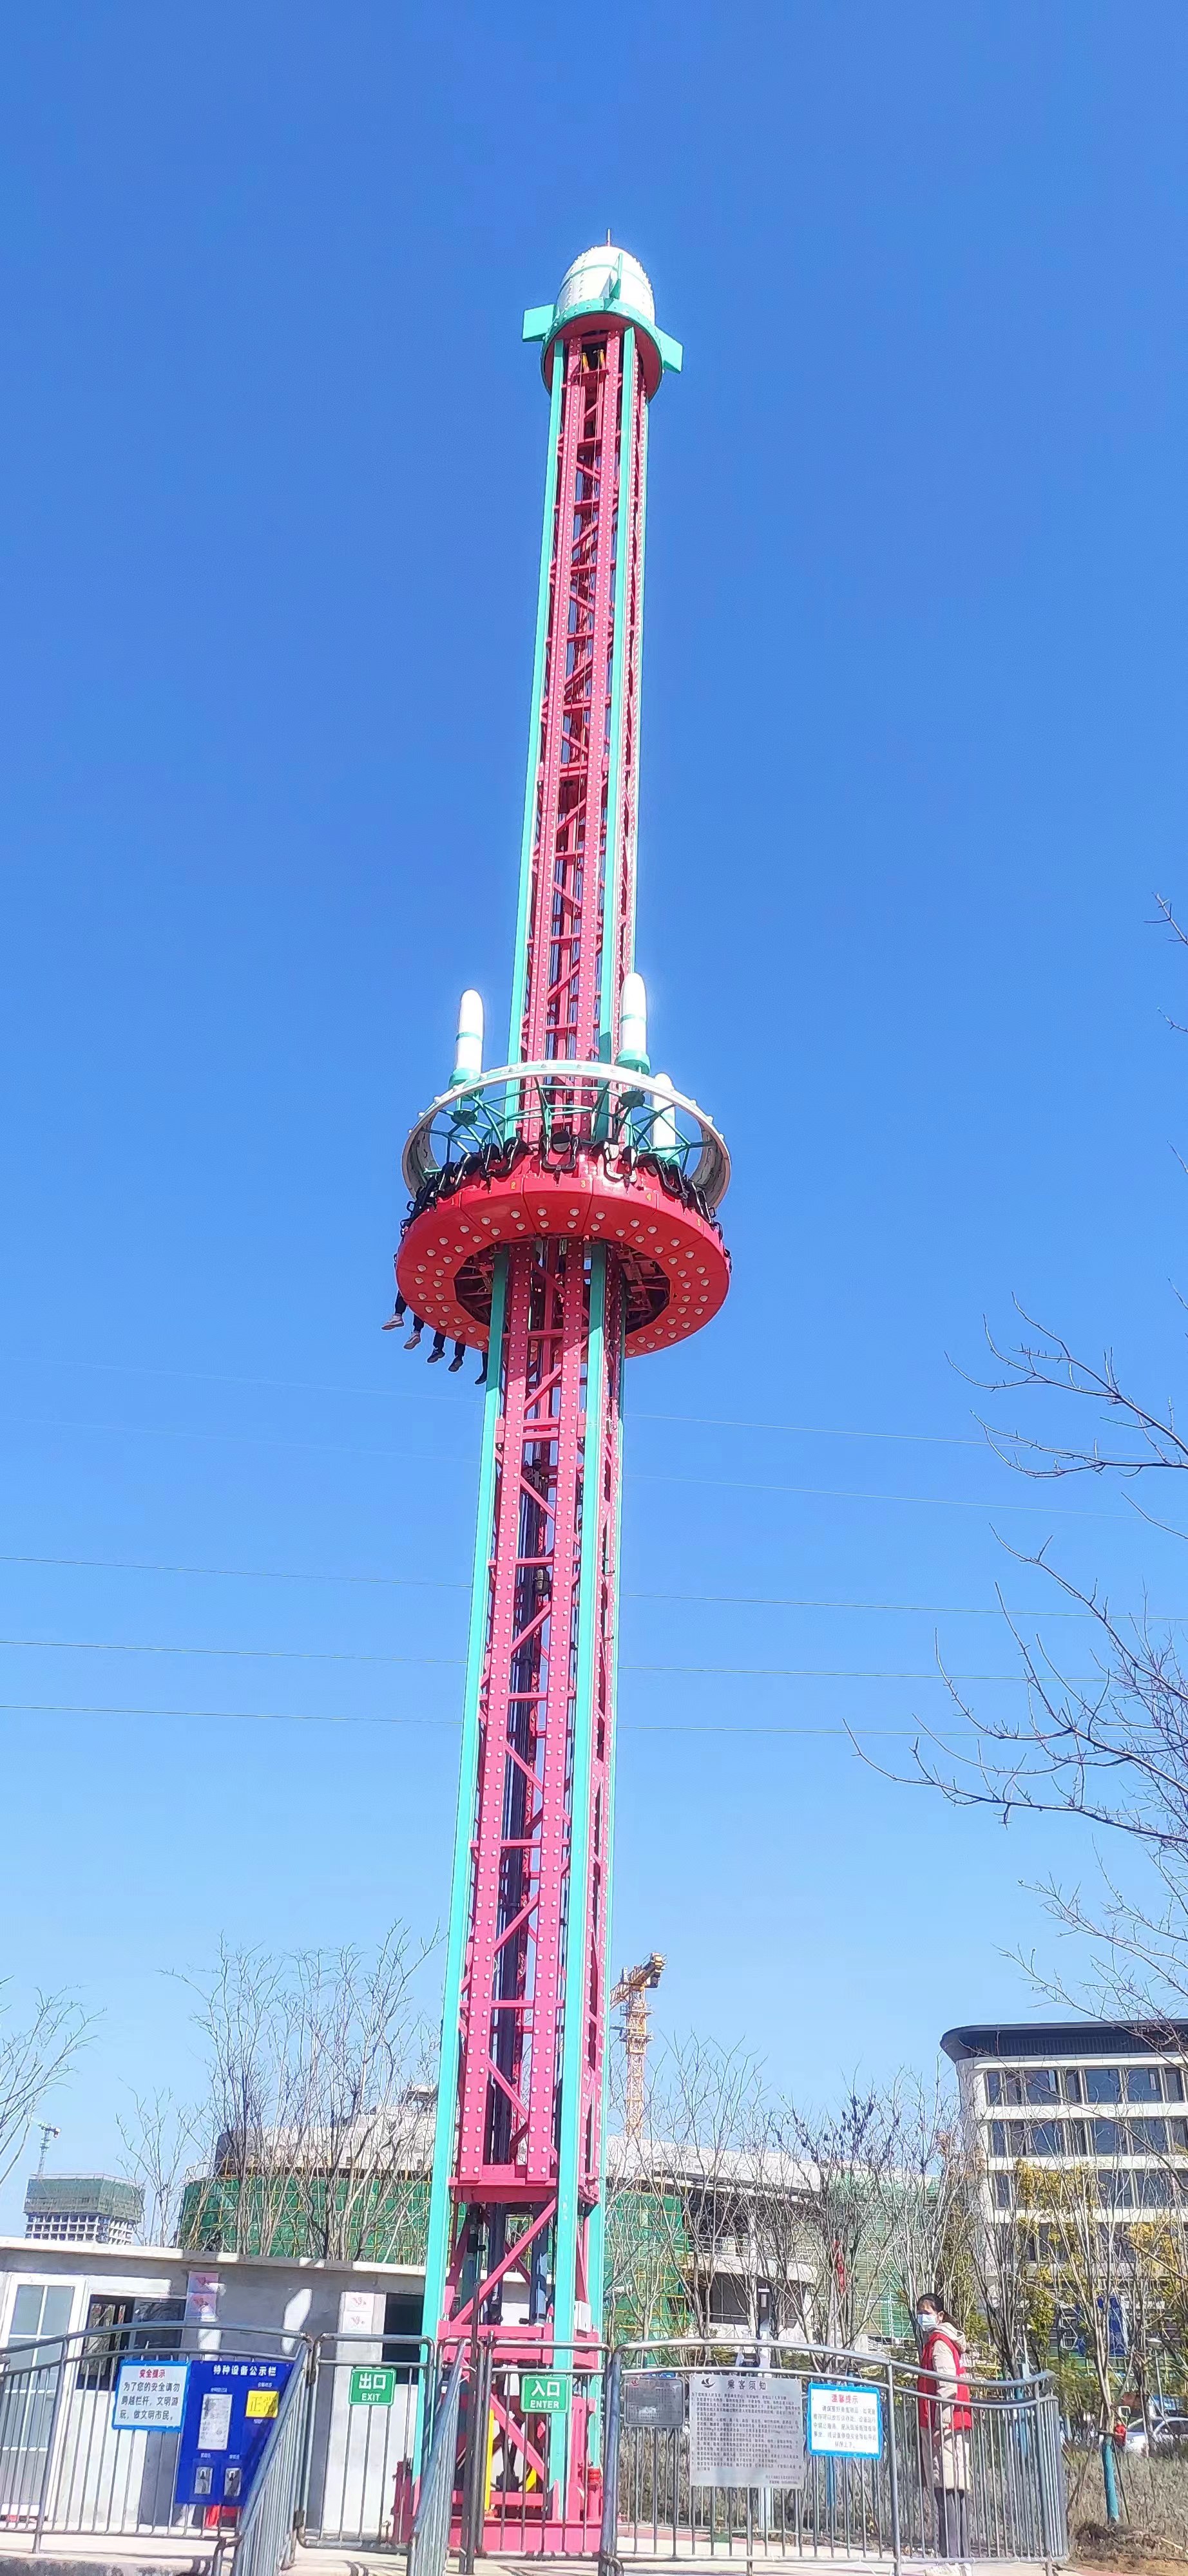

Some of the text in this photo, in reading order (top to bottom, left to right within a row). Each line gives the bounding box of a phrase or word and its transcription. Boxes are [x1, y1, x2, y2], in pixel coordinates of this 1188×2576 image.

[580, 1180, 586, 1188] 3
[646, 1193, 651, 1201] 4
[213, 2364, 277, 2377] 特种设备公示栏
[358, 2372, 387, 2390] 出口
[727, 2379, 766, 2391] 乘客须知
[123, 2382, 180, 2392] 为了您的安全请勿
[531, 2380, 560, 2396] 入口
[361, 2392, 381, 2401] EXIT
[832, 2394, 858, 2404] 温馨提示
[530, 2400, 559, 2409] ENTER
